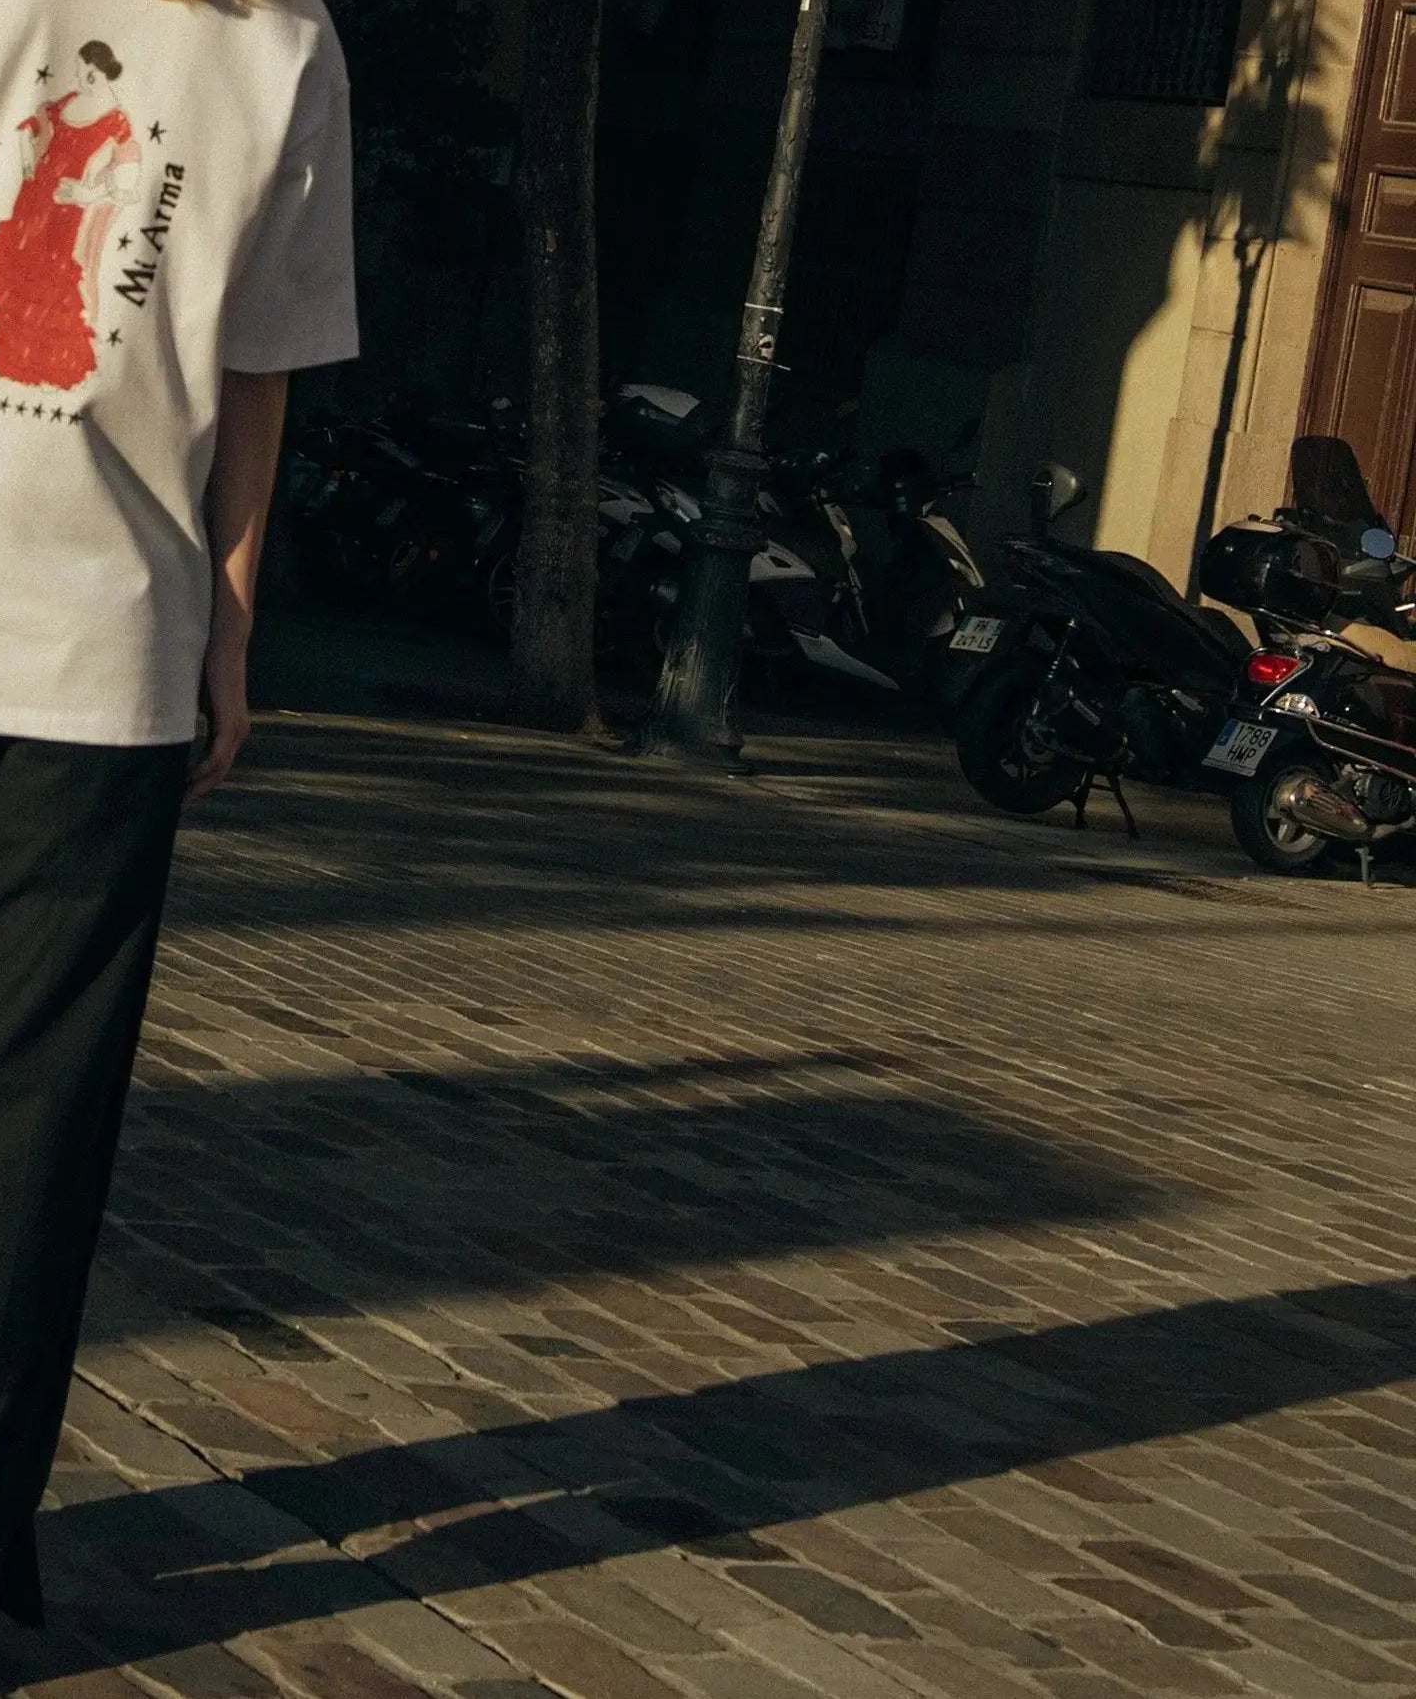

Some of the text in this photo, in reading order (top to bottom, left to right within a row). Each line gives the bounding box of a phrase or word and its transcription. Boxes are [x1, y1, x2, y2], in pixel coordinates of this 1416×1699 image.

[114, 162, 184, 308] Mi Arma
[1235, 725, 1272, 747] 1788
